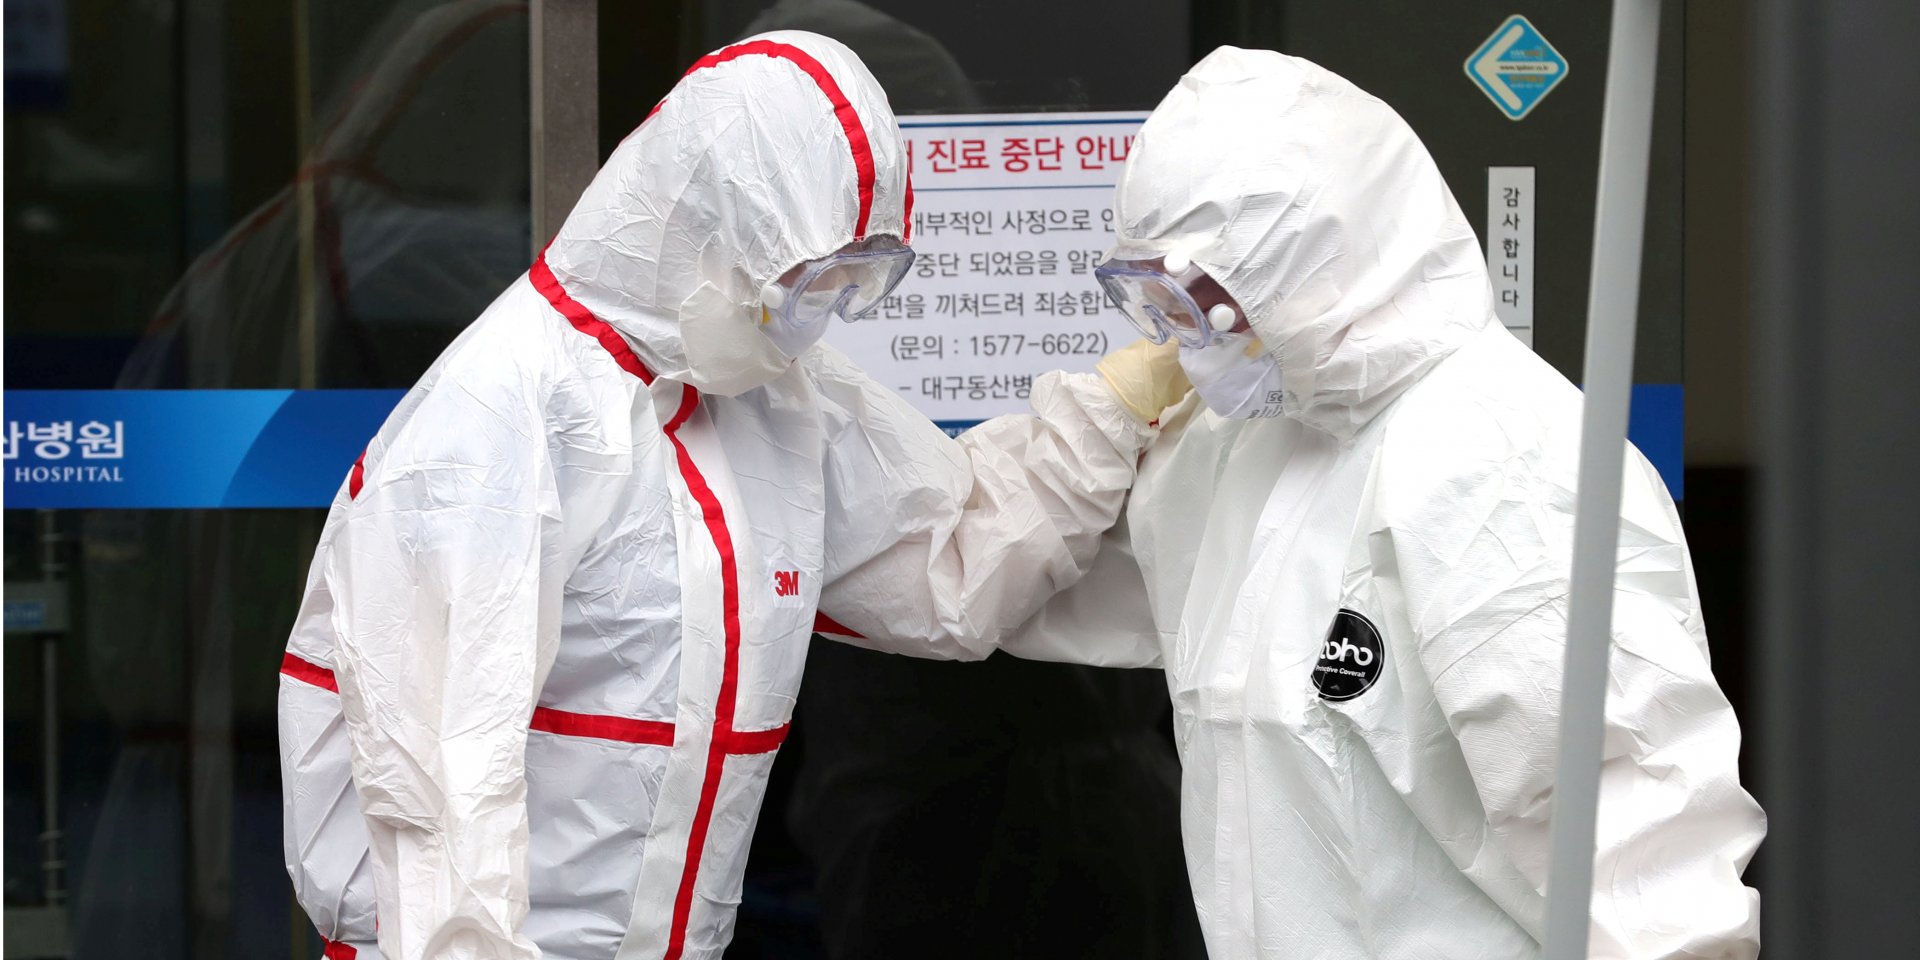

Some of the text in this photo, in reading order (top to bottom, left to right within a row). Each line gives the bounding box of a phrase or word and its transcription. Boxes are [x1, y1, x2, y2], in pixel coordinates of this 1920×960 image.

[927, 138, 990, 173] 진료
[1001, 136, 1064, 173] 중단
[1001, 209, 1092, 235] 사정으로
[1501, 187, 1521, 308] 감사합니다
[915, 252, 960, 278] 중단
[970, 251, 1059, 276] 되었음을
[934, 292, 1024, 318] 끼쳐드려
[891, 335, 944, 361] (문의
[971, 331, 1108, 358] 1577-6622)
[922, 373, 1044, 400] 대구동산병
[14, 466, 124, 483] HOSPITAL
[774, 570, 799, 597] 3M
[1339, 667, 1366, 678] Coverall
